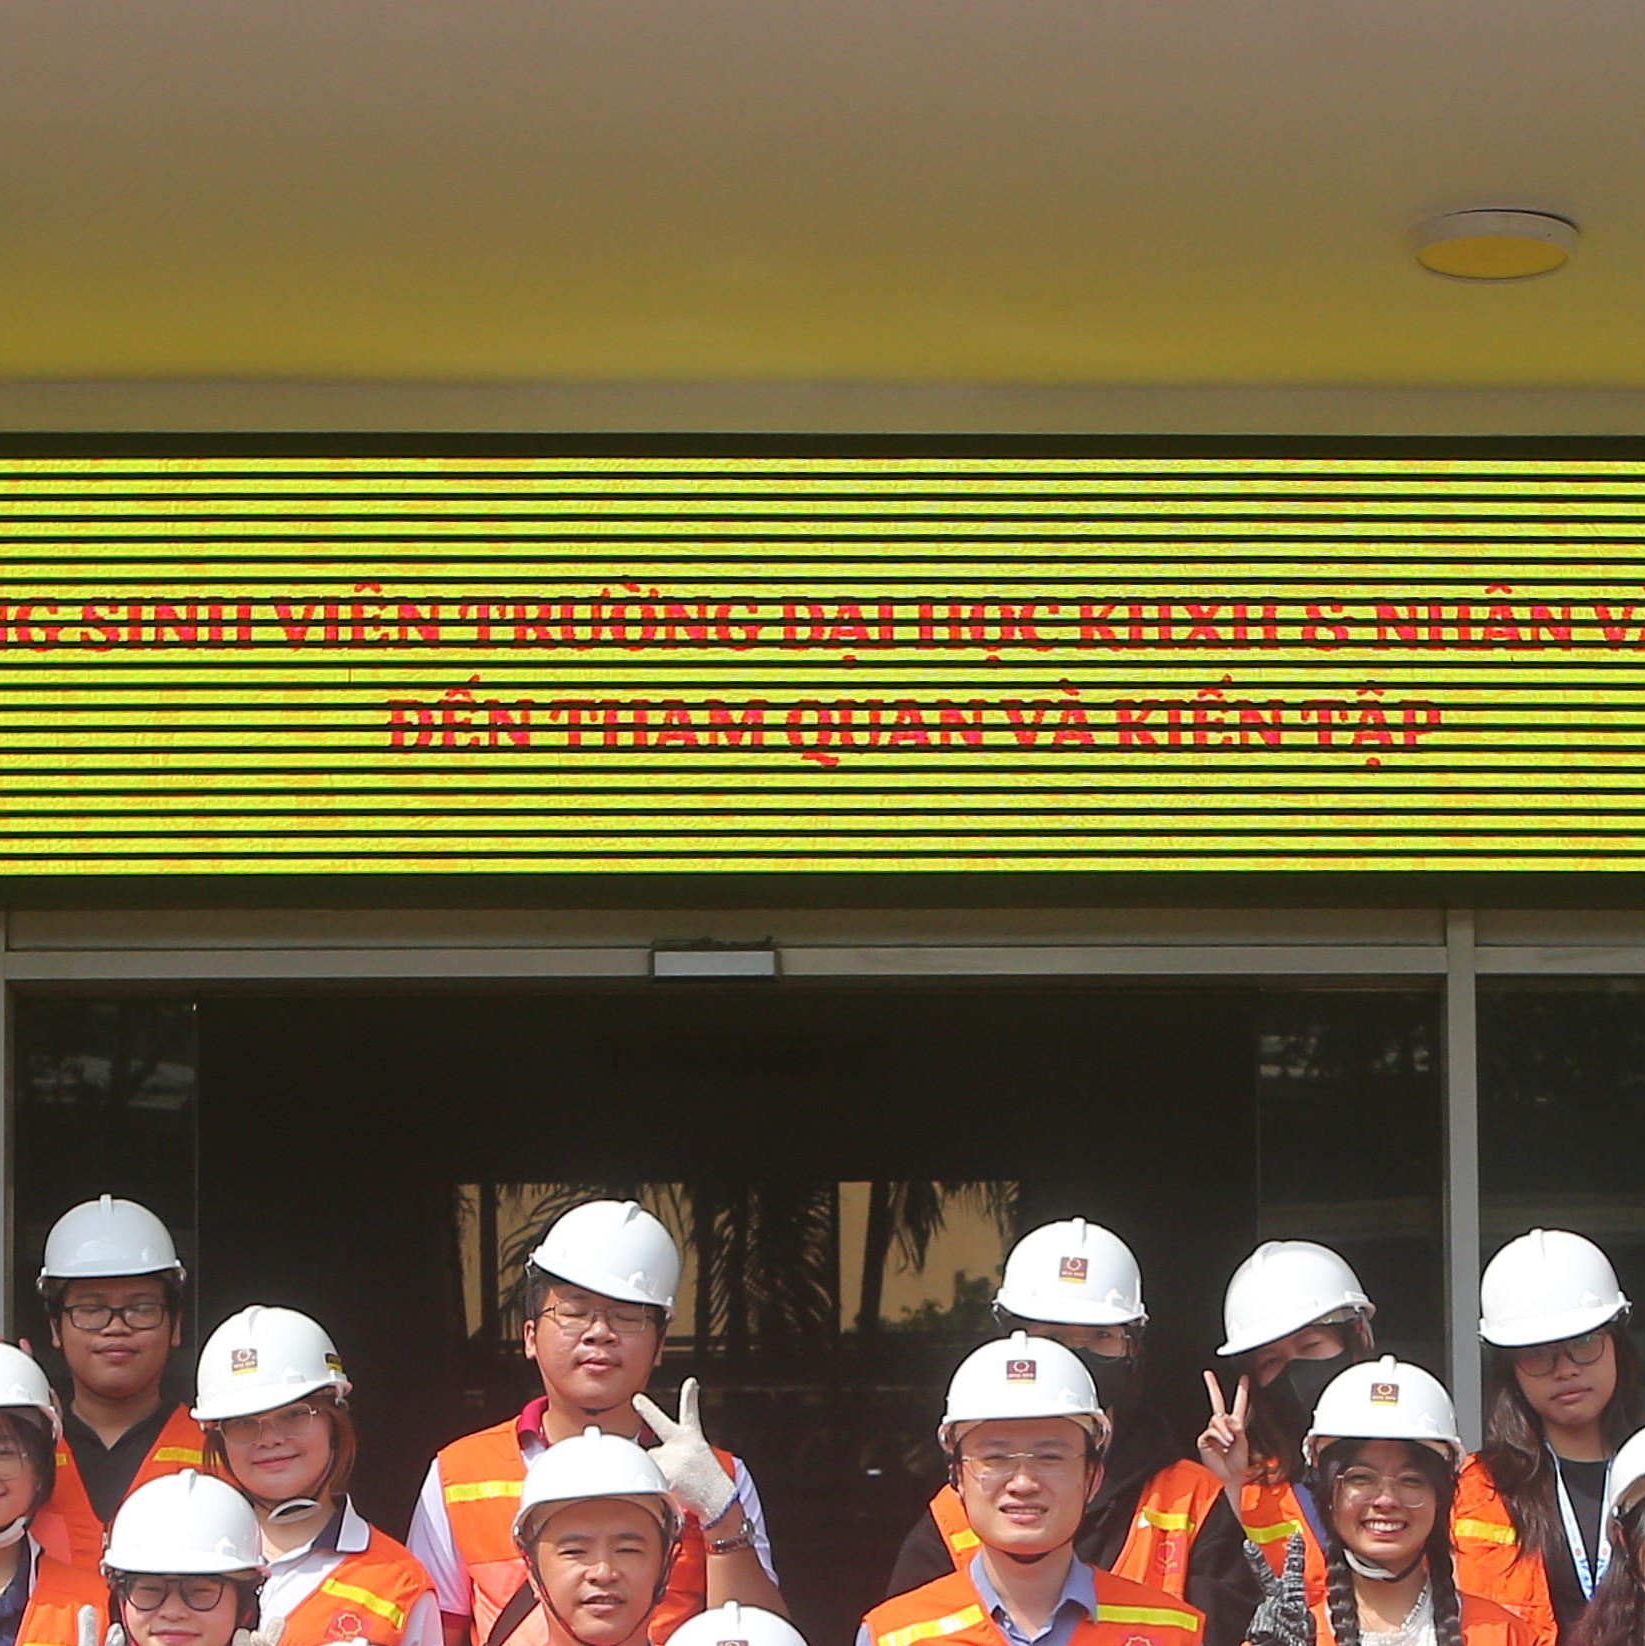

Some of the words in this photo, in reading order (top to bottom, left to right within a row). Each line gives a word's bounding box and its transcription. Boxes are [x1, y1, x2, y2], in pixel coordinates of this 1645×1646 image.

[78, 597, 256, 652] SINH
[273, 577, 441, 652] VIÊN
[1371, 583, 1576, 652] NHÂN
[549, 697, 767, 752] THAM
[785, 697, 986, 769] QUAN
[1000, 678, 1098, 752] VÀ
